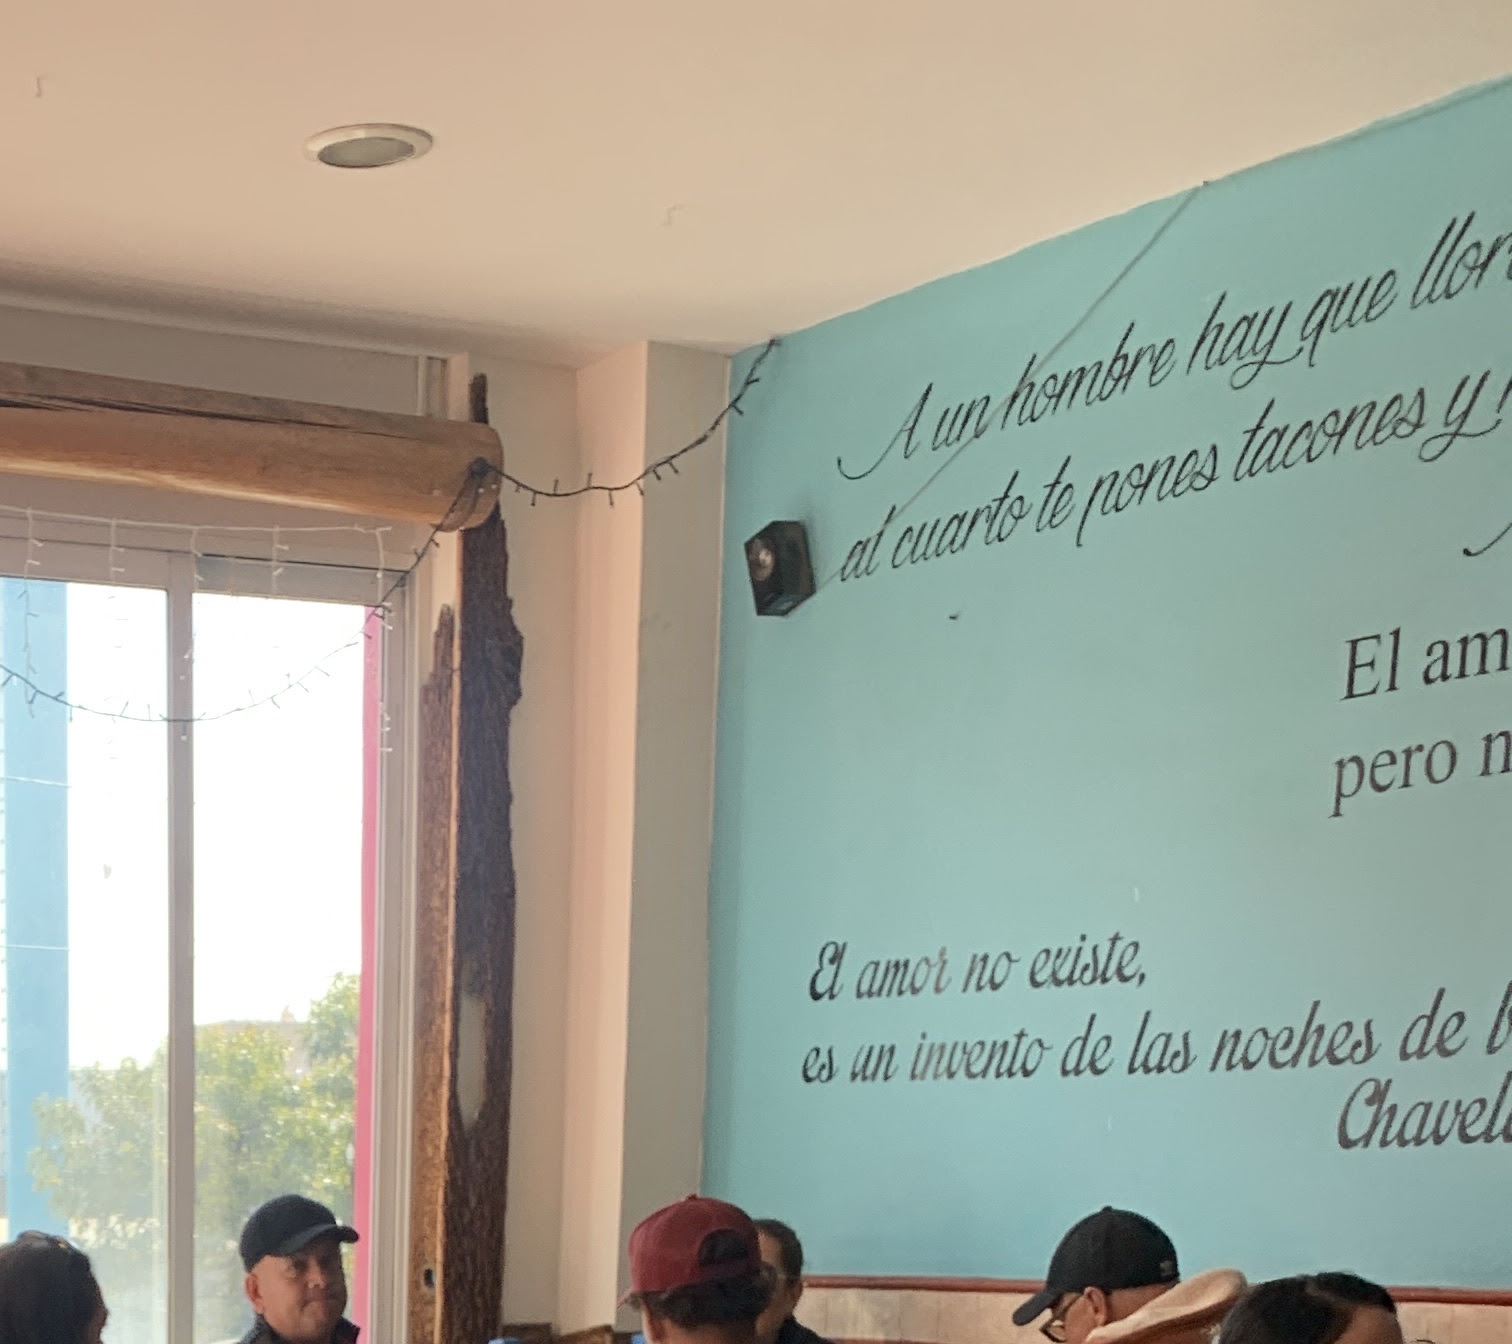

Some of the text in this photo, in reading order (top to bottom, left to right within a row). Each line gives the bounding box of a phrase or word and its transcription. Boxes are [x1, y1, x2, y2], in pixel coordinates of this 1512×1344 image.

[837, 381, 935, 480] A
[930, 393, 992, 452] un
[1000, 320, 1178, 430] hombre
[1186, 291, 1304, 391] hay
[1300, 268, 1400, 369] que
[838, 505, 895, 583] al
[890, 469, 1034, 570] cuarto
[1035, 454, 1077, 534] te
[1074, 442, 1221, 550] pones
[1232, 386, 1428, 483] tacones
[1418, 368, 1504, 464] y
[1339, 626, 1402, 702] El
[1327, 739, 1460, 819] pero
[809, 930, 1147, 1002] El amor no existe,
[801, 1045, 840, 1085] es
[848, 1044, 900, 1084] un
[908, 1027, 1054, 1083] invento
[1059, 1013, 1115, 1079] de
[1126, 1009, 1199, 1076] las
[1208, 1000, 1383, 1074] noches
[1398, 987, 1470, 1063] de
